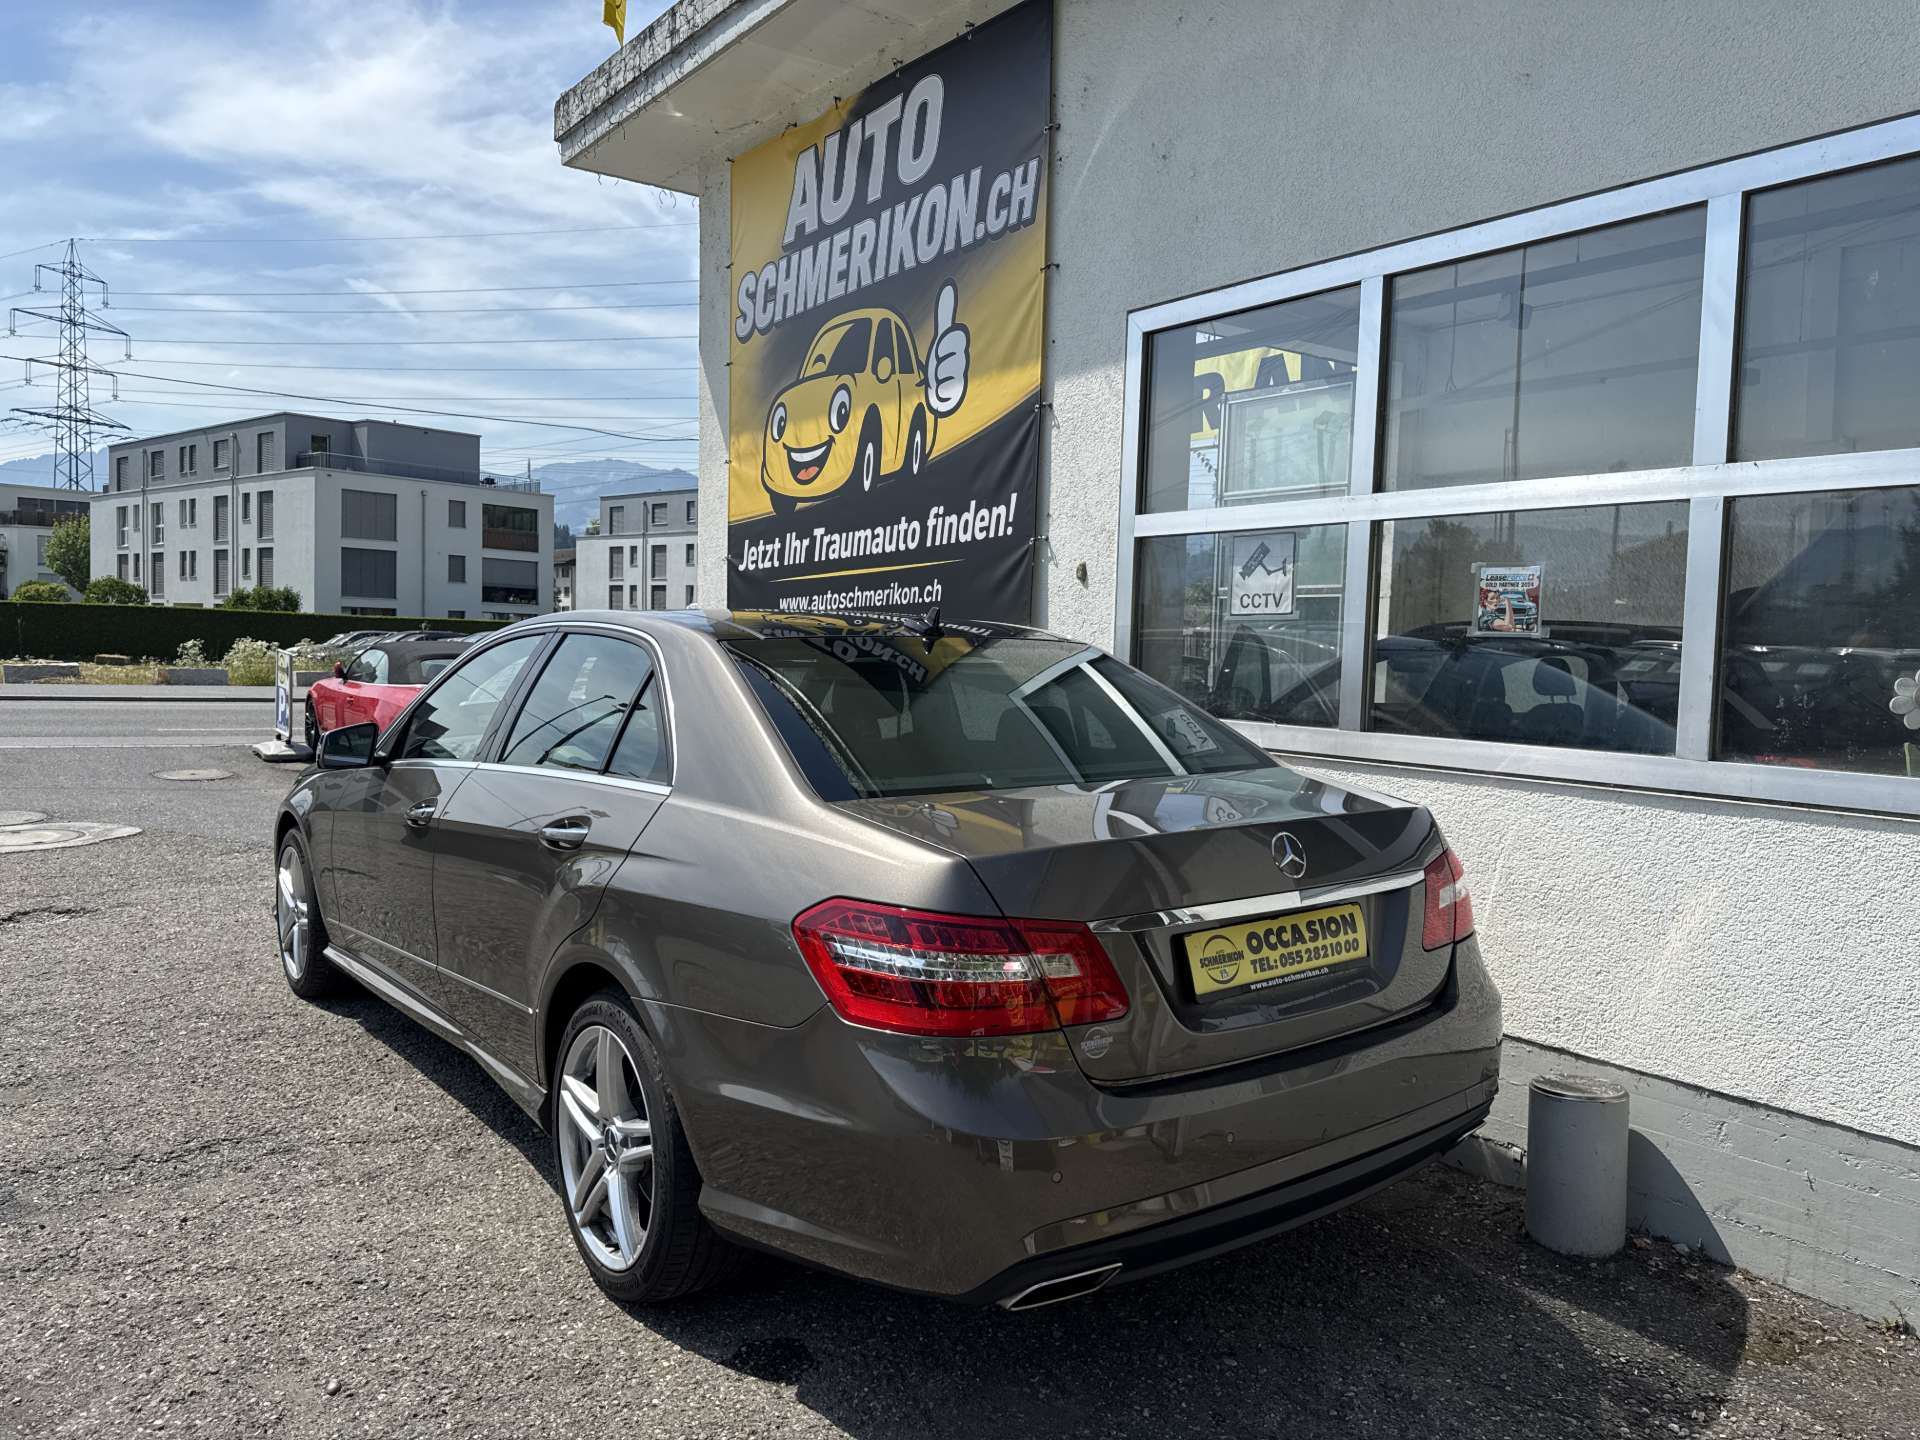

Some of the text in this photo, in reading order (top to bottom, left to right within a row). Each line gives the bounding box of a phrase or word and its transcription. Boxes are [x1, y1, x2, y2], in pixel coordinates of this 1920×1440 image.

[782, 73, 945, 249] AUTO
[734, 155, 1041, 341] SCHMERIKON.CH
[738, 492, 1018, 572] Jetzt Ihr Traumauto finden!
[778, 578, 942, 612] www.autoschmerikon.ch
[1240, 592, 1284, 609] CCTV
[1246, 912, 1358, 955] OCCASION
[1250, 956, 1279, 975] TEL:
[1279, 950, 1304, 968] 055
